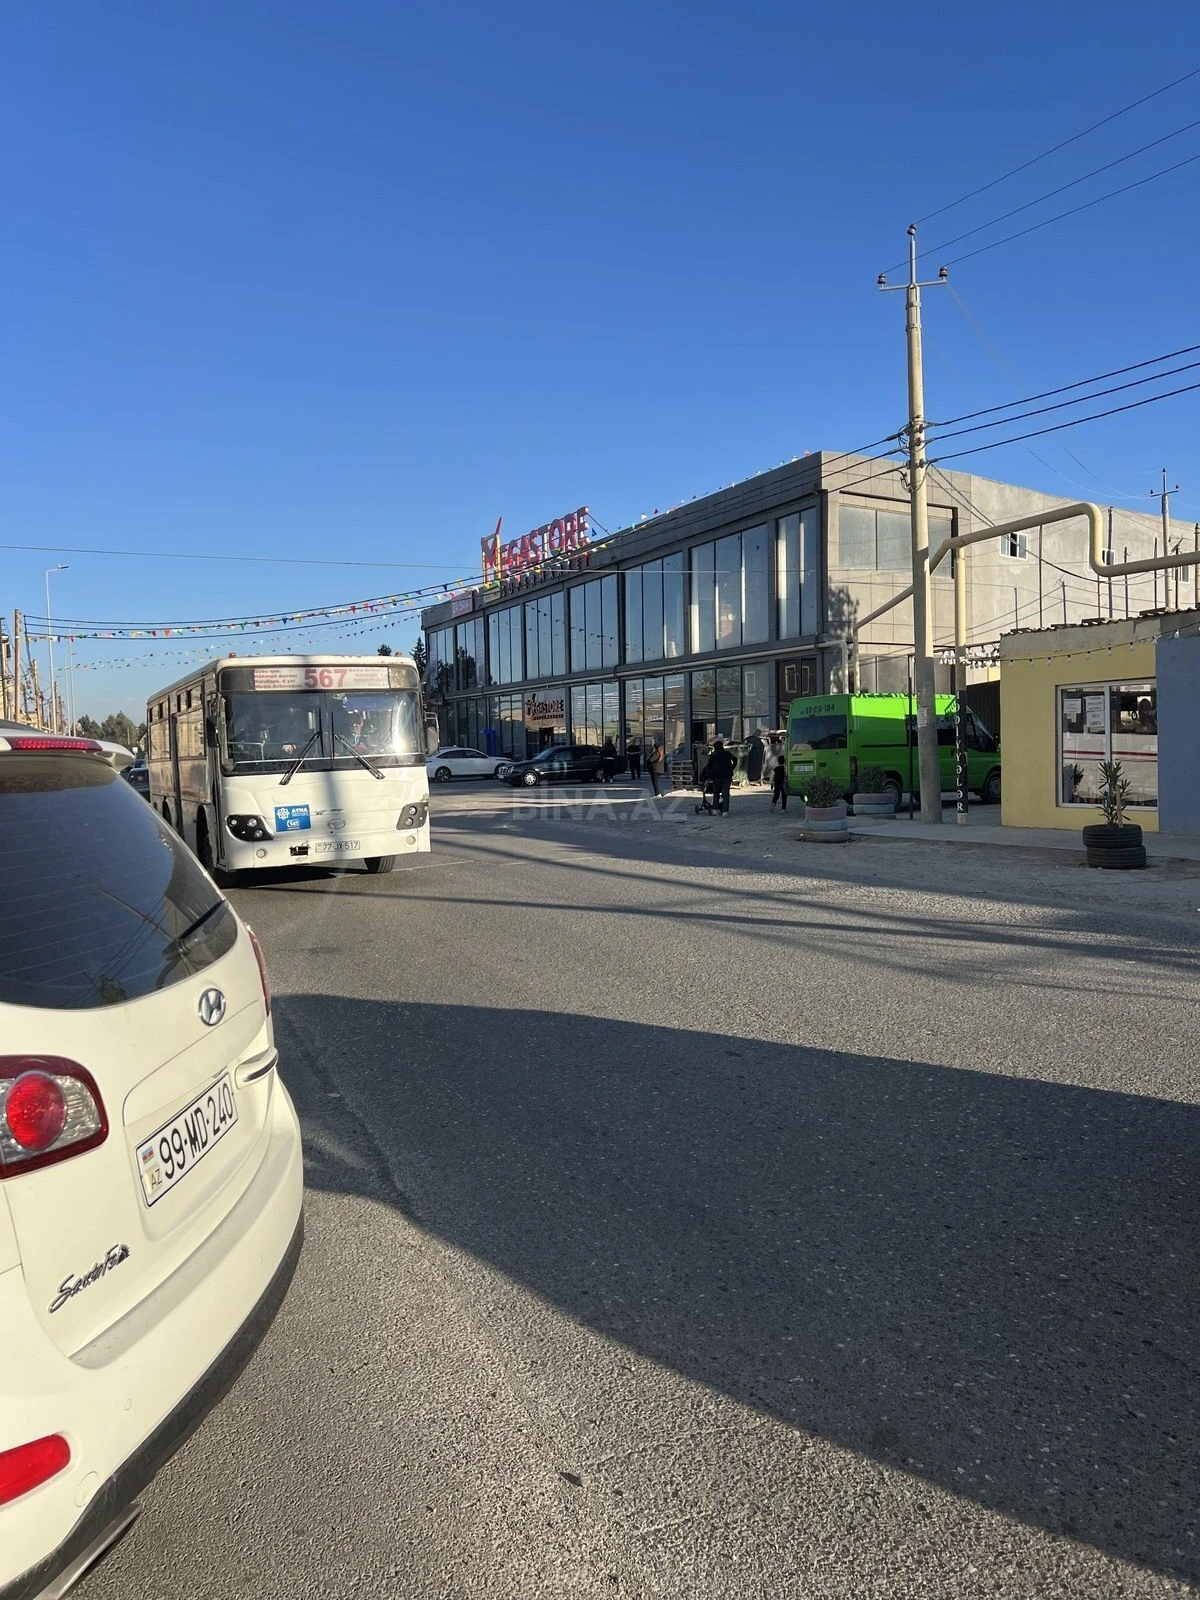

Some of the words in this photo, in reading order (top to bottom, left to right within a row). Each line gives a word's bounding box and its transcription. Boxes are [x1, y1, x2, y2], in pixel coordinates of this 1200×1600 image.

[480, 505, 590, 583] MEGASTORE
[304, 668, 347, 689] 567
[322, 841, 359, 852] 77-JX-517
[159, 1082, 234, 1180] 99-MD-240
[151, 1168, 163, 1190] AZ
